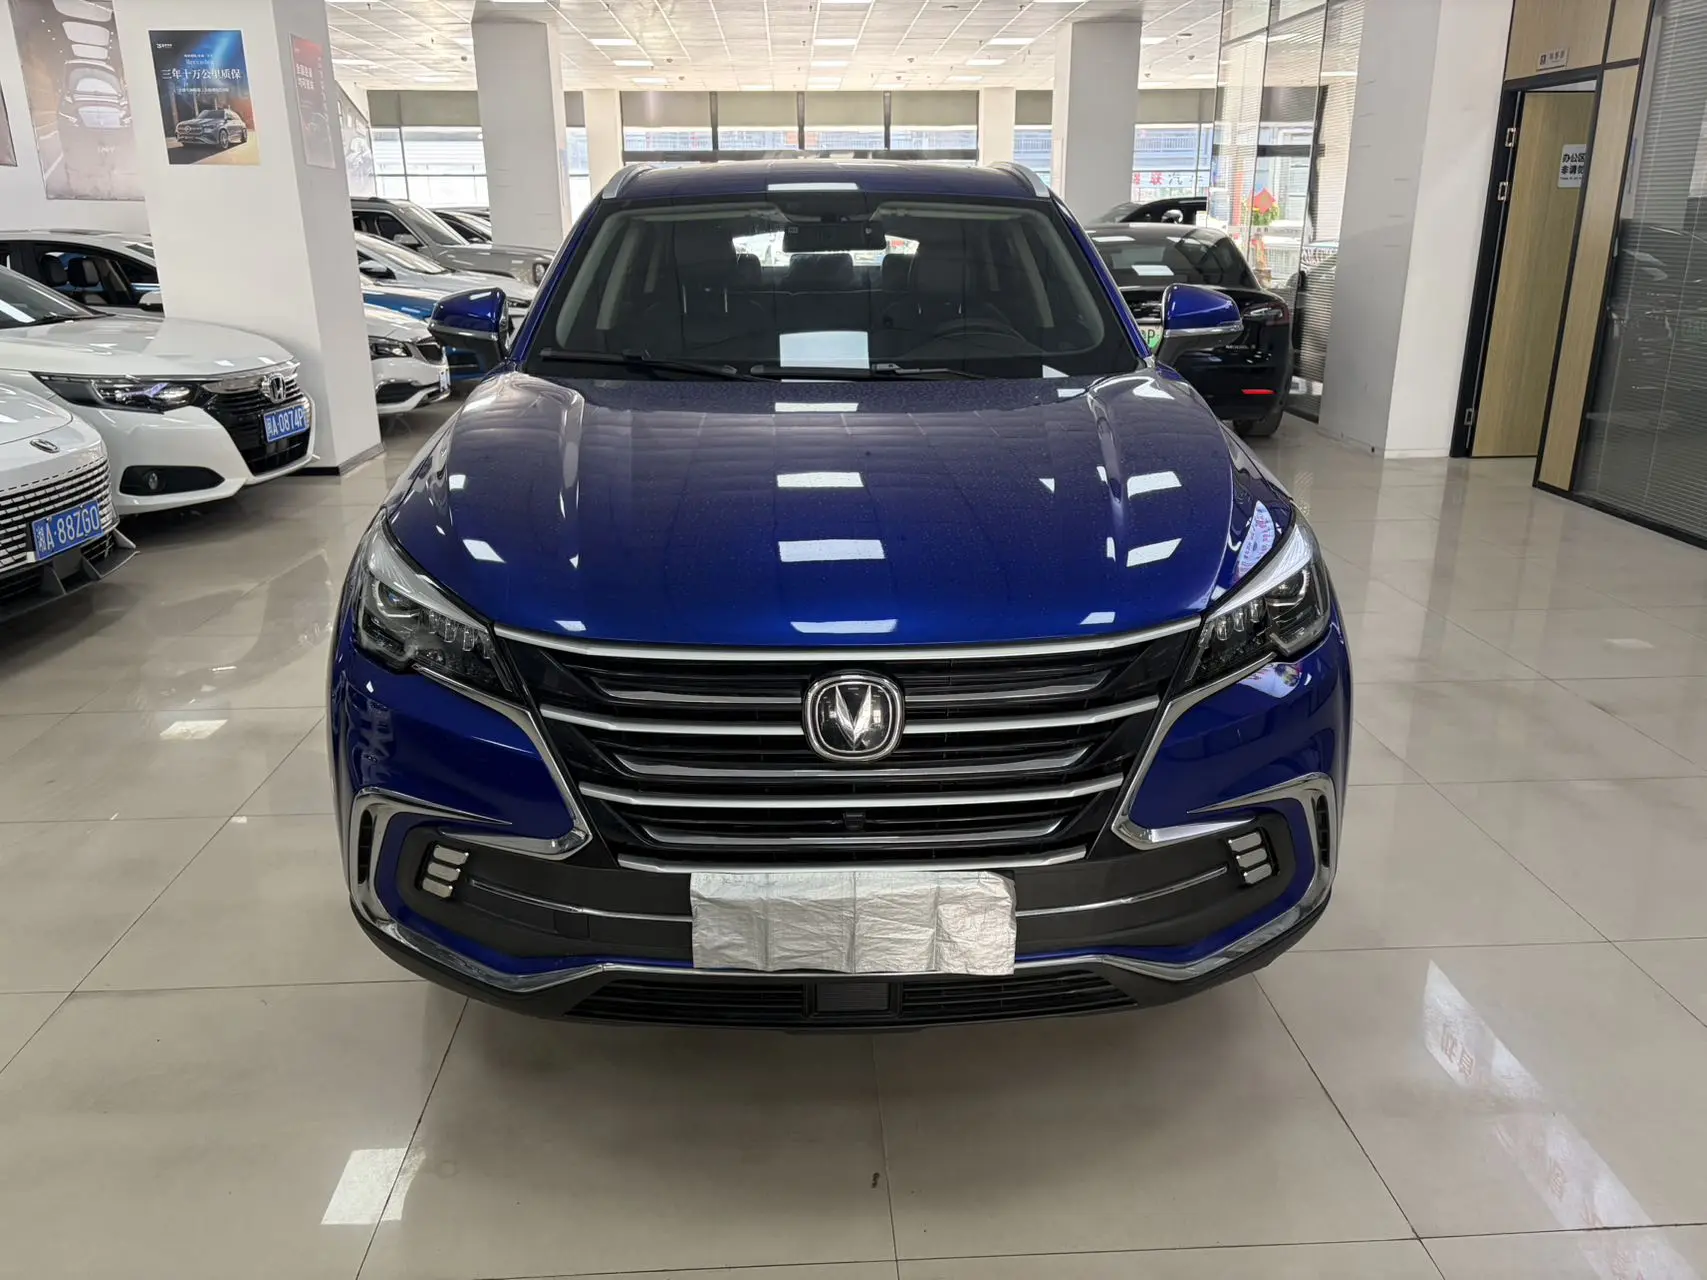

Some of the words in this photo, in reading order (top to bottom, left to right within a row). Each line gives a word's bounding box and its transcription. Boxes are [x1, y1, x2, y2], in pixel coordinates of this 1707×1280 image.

[161, 68, 241, 80] 三年十万公里质保
